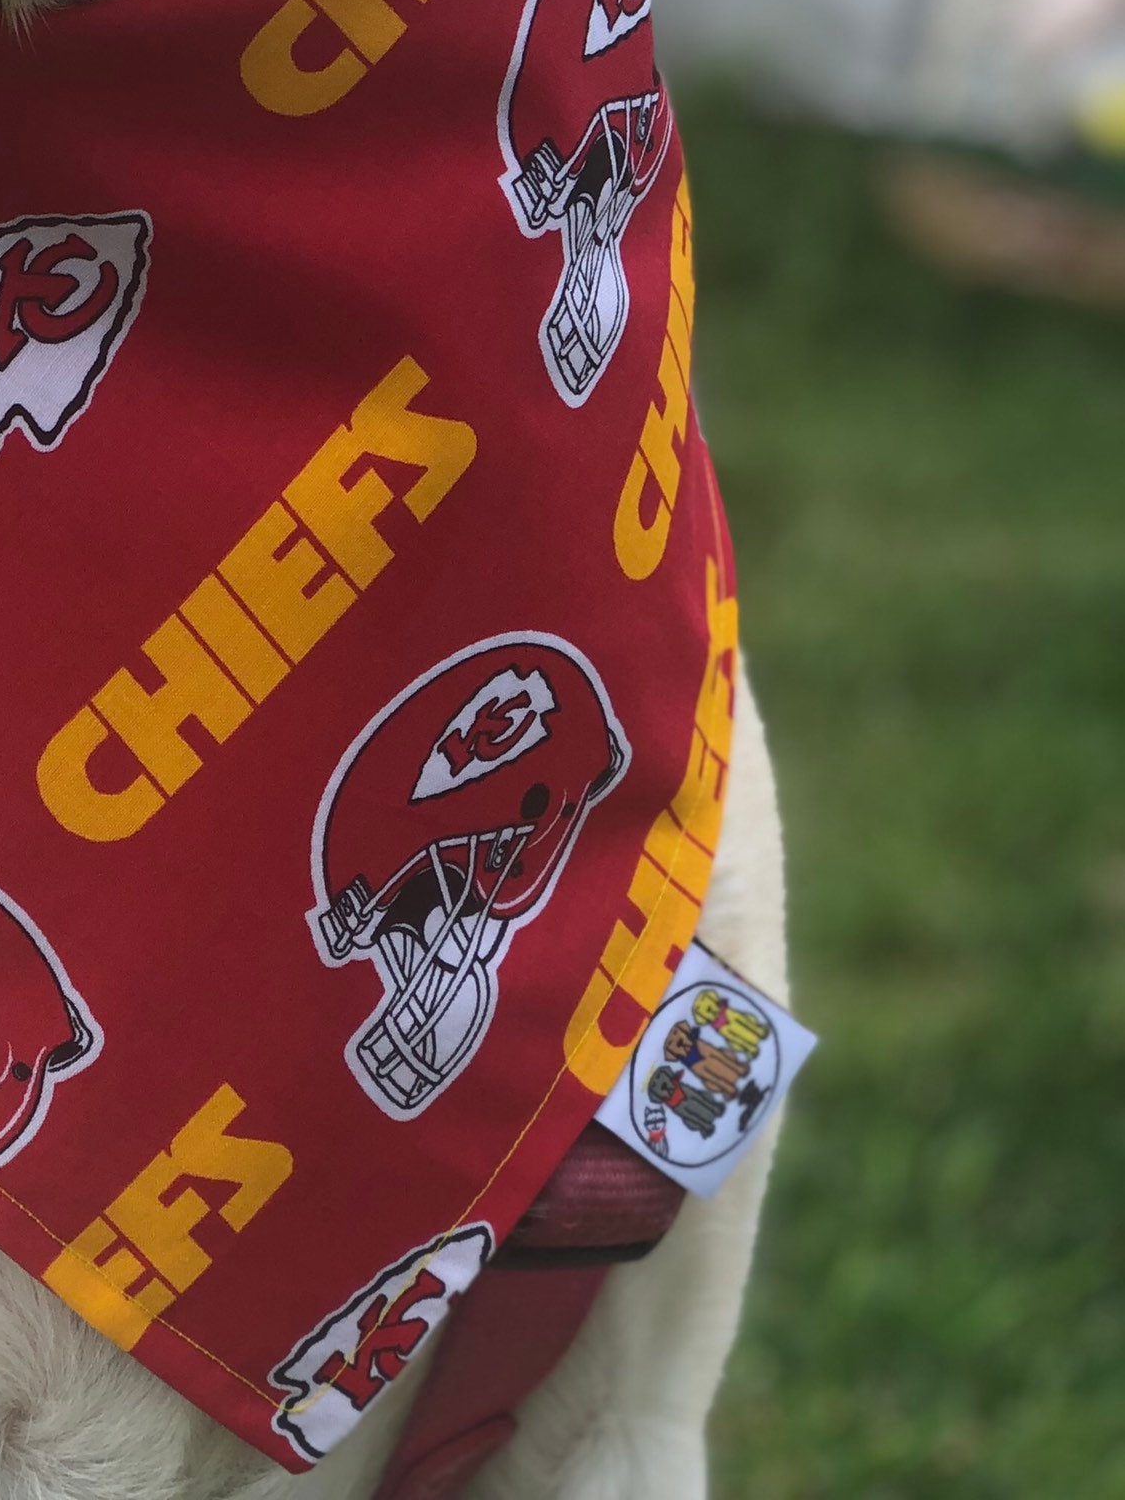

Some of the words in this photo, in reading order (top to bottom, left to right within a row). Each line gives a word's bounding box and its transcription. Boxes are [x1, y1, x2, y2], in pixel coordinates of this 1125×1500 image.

[36, 355, 477, 842] CHIEFS
[437, 690, 537, 778] KC
[563, 554, 738, 1096] CHIEFS
